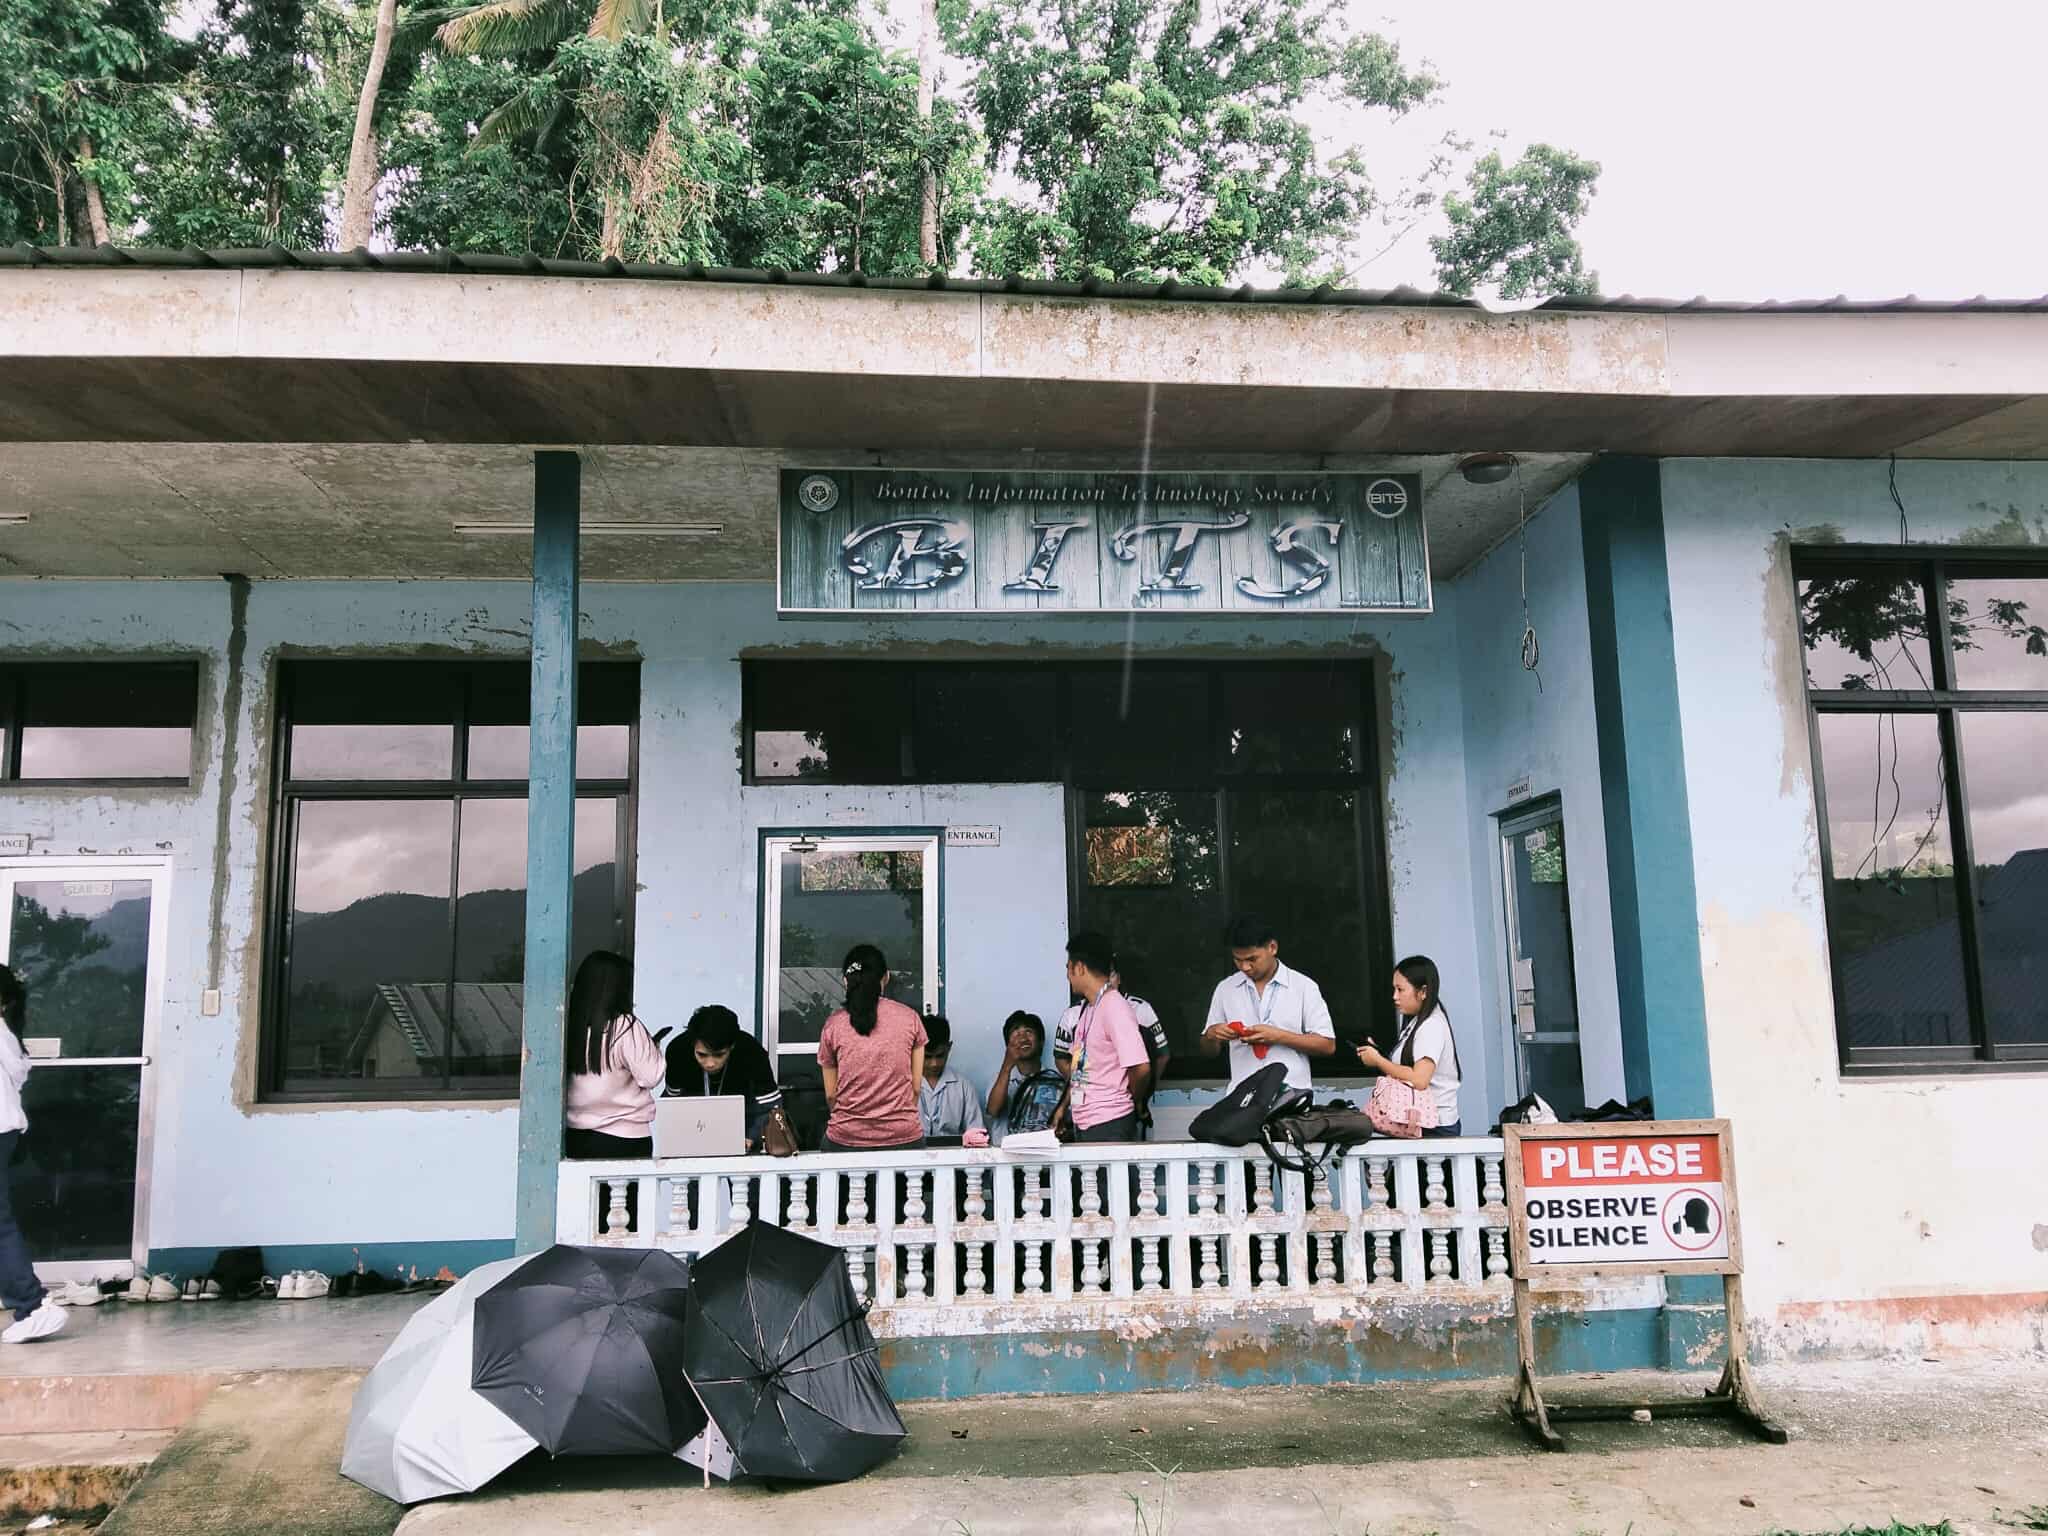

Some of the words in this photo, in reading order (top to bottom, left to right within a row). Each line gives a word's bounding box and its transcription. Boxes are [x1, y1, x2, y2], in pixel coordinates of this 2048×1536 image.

[876, 482, 952, 500] Bontoc
[967, 482, 1106, 504] Information
[1119, 483, 1244, 506] Technology
[1254, 484, 1336, 504] Society
[1367, 493, 1408, 504] BITS
[947, 832, 996, 840] ENTRANCE
[1541, 1144, 1703, 1178] PLEASE
[1526, 1197, 1657, 1219] OBSERVE
[1528, 1225, 1649, 1248] SILENCE
